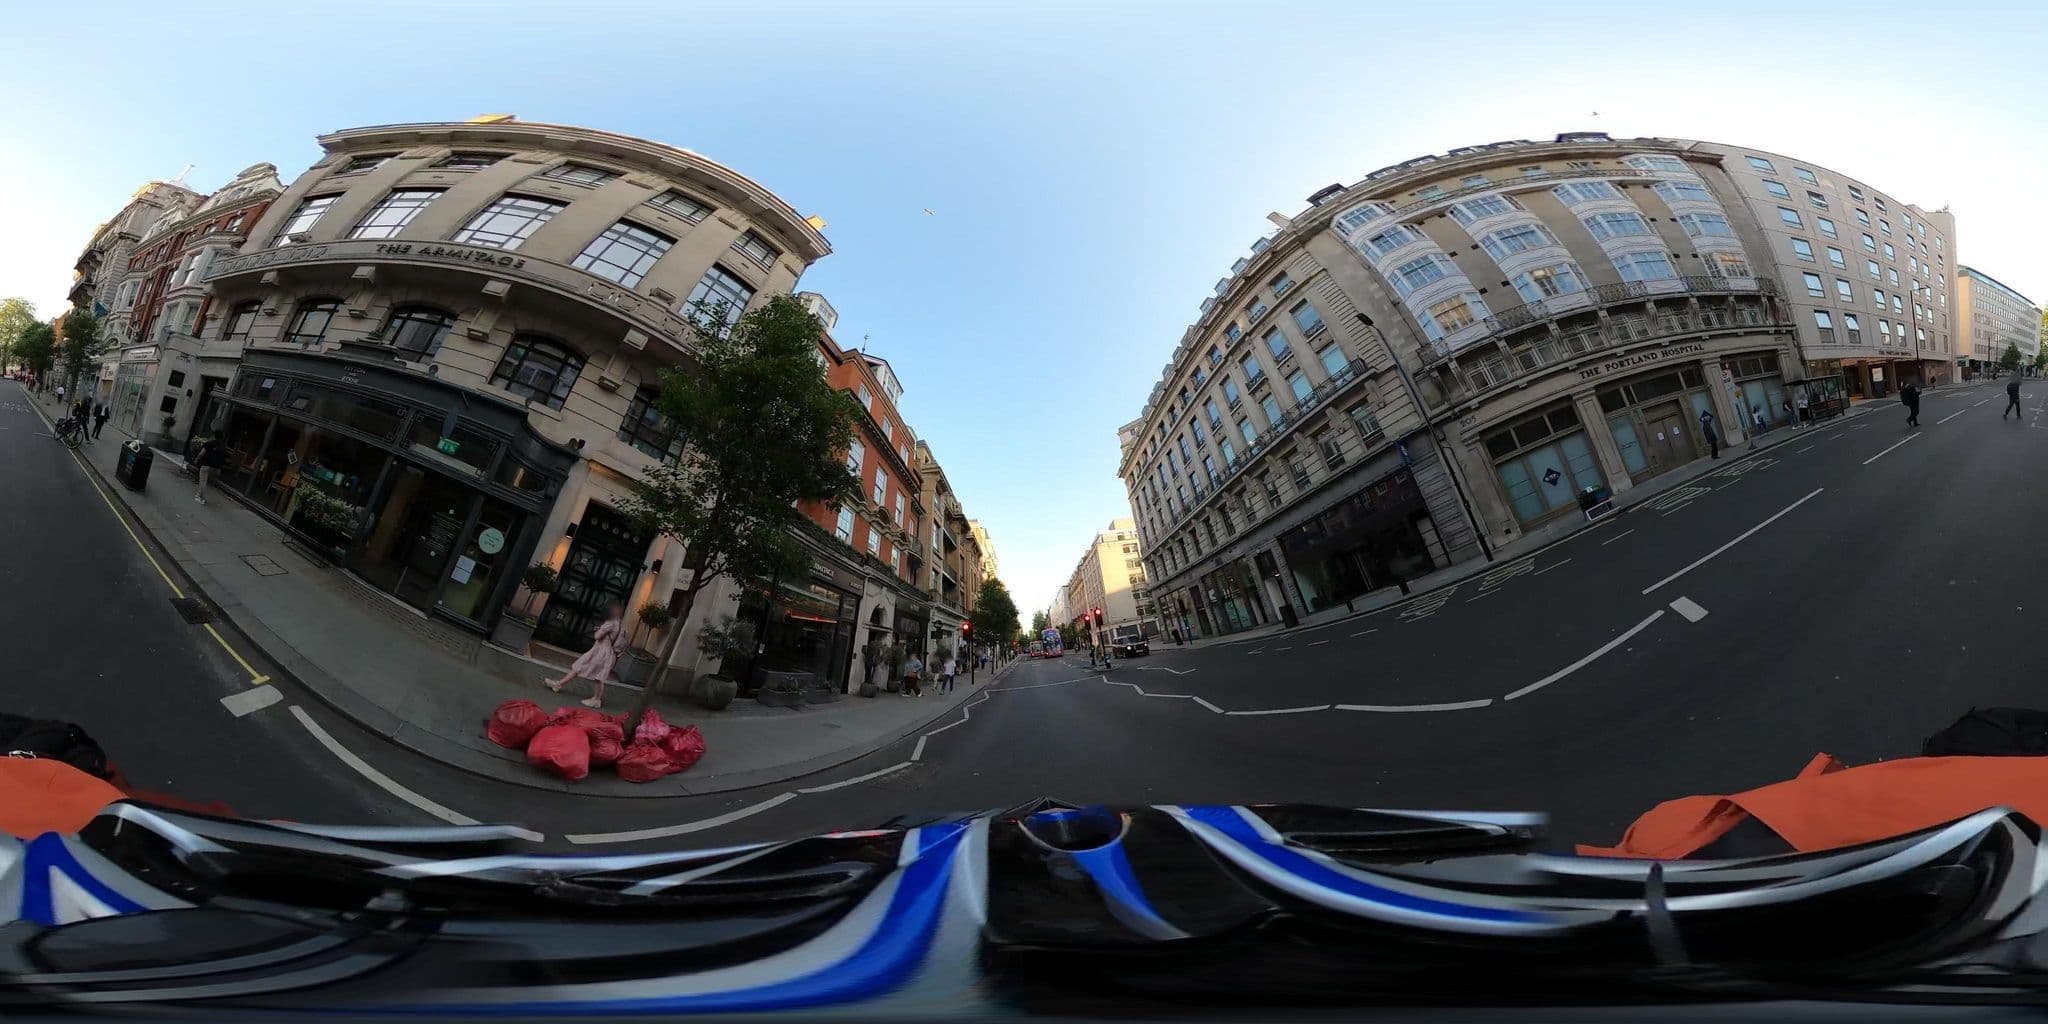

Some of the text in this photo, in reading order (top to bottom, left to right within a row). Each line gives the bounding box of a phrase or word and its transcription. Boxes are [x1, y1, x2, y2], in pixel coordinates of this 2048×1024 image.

[376, 243, 526, 269] THE ARMITAGE
[1579, 343, 1705, 380] THE PORTLAND HOSPITAL
